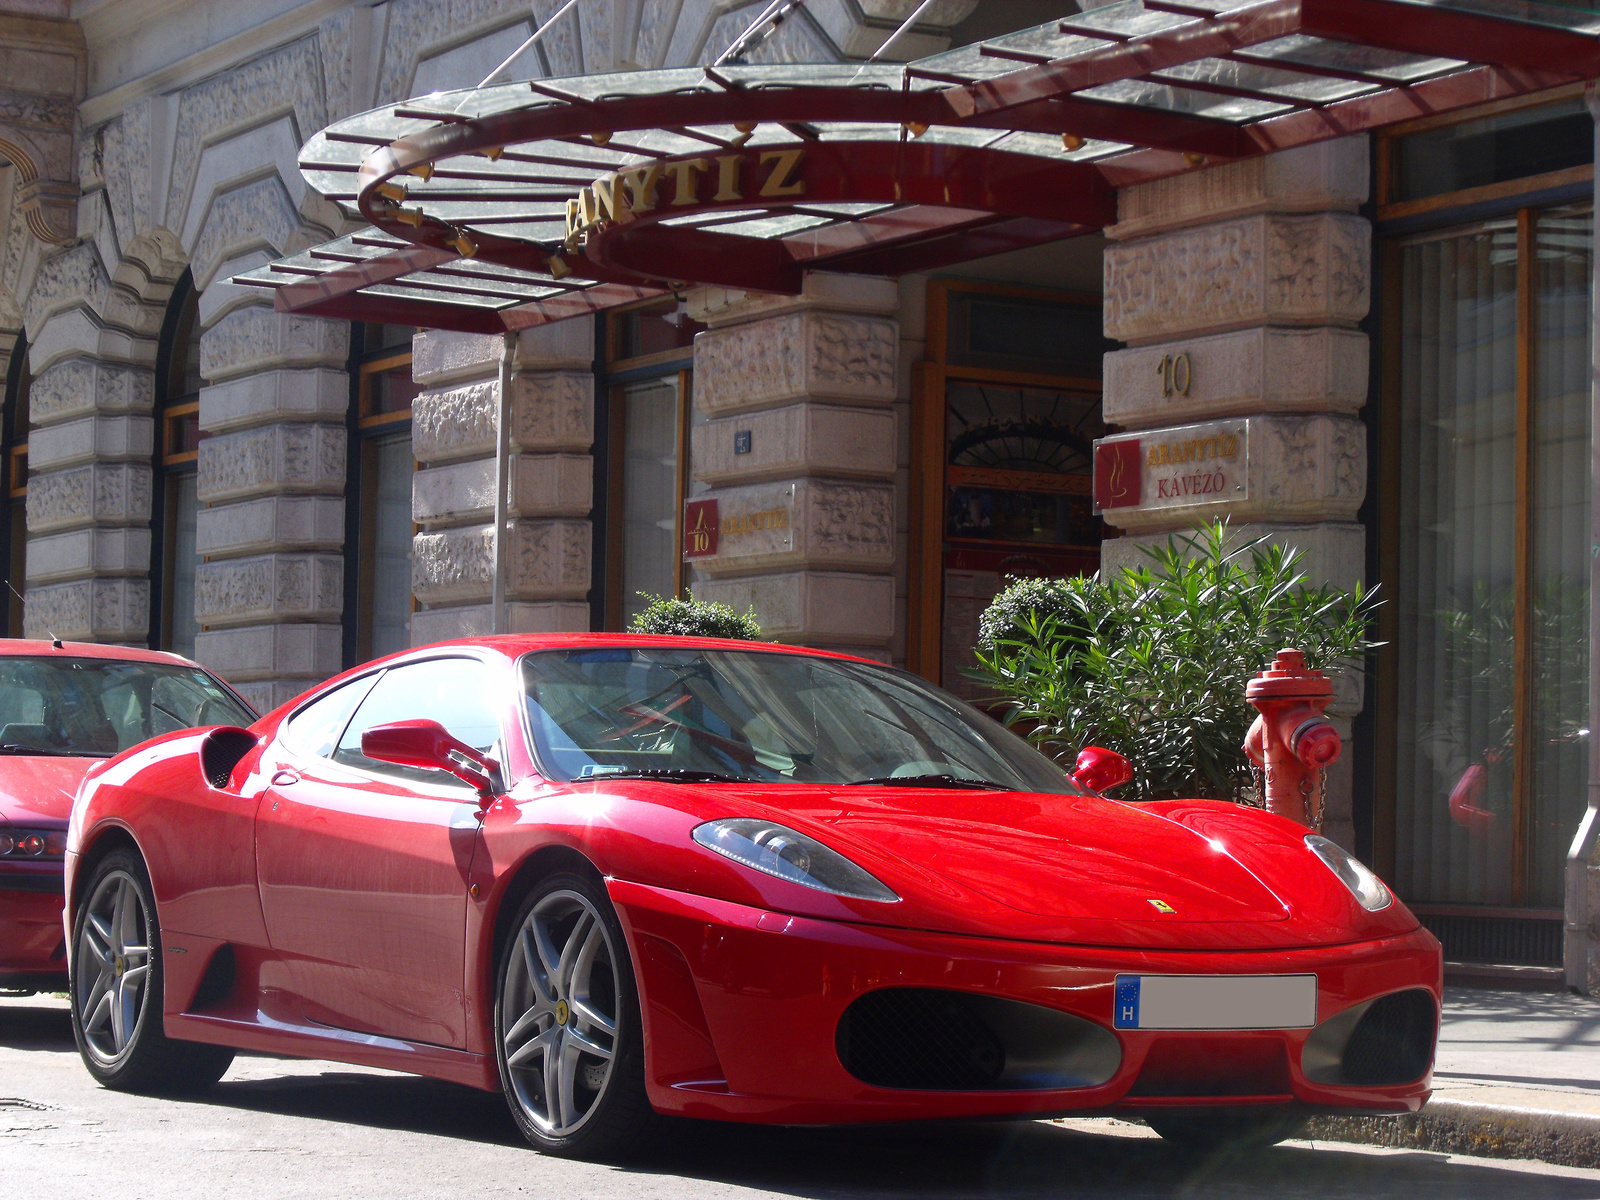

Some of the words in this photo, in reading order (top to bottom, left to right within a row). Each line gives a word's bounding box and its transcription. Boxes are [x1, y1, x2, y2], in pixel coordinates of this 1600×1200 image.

[1156, 353, 1191, 398] 10
[1147, 430, 1239, 466] ARANYTÍZ
[1157, 466, 1225, 499] KÁVÉZÓ
[1121, 1006, 1134, 1021] H
